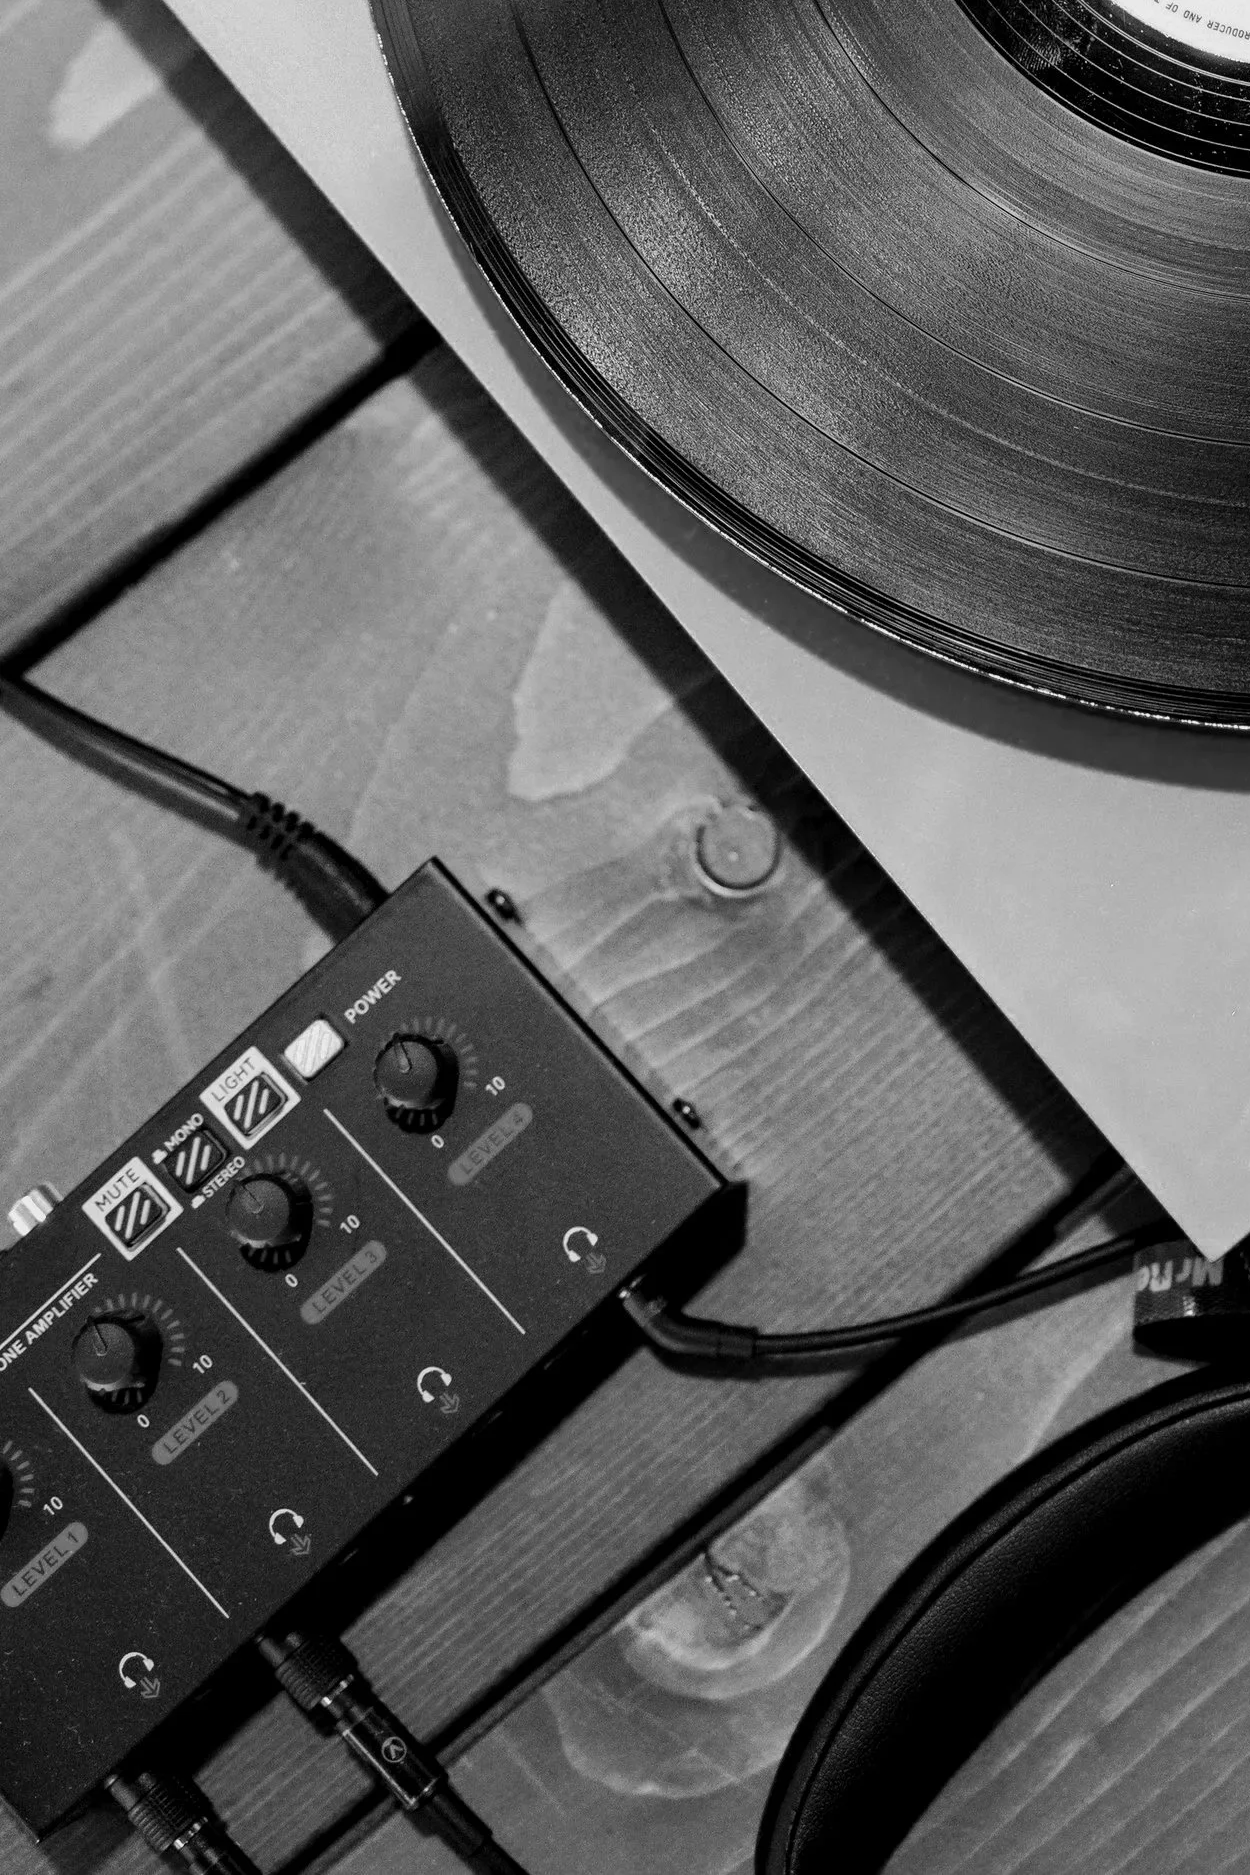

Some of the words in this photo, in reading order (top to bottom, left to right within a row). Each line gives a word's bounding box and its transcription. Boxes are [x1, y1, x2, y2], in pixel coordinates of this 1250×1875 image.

[1165, 2, 1179, 14] OF
[1183, 9, 1203, 24] AND
[343, 969, 402, 1024] POWER
[210, 1056, 255, 1103] LIGHT
[484, 1075, 506, 1096] 10
[163, 1112, 204, 1152] MONO
[430, 1134, 445, 1149] 0
[459, 1127, 514, 1176] LEVEL
[94, 1167, 140, 1212] MUTE
[201, 1155, 246, 1198] STEREO
[339, 1214, 360, 1234] 10
[284, 1273, 299, 1288] 0
[311, 1263, 367, 1314] LEVEL
[363, 1249, 378, 1264] 3
[25, 1273, 98, 1345] AMPLIFIER
[192, 1354, 213, 1374] 10
[136, 1413, 150, 1428] 0
[162, 1404, 220, 1455] LEVEL
[215, 1389, 231, 1405] 2
[43, 1496, 63, 1515] 10
[12, 1546, 70, 1596] LEVEL
[67, 1531, 79, 1543] 1
